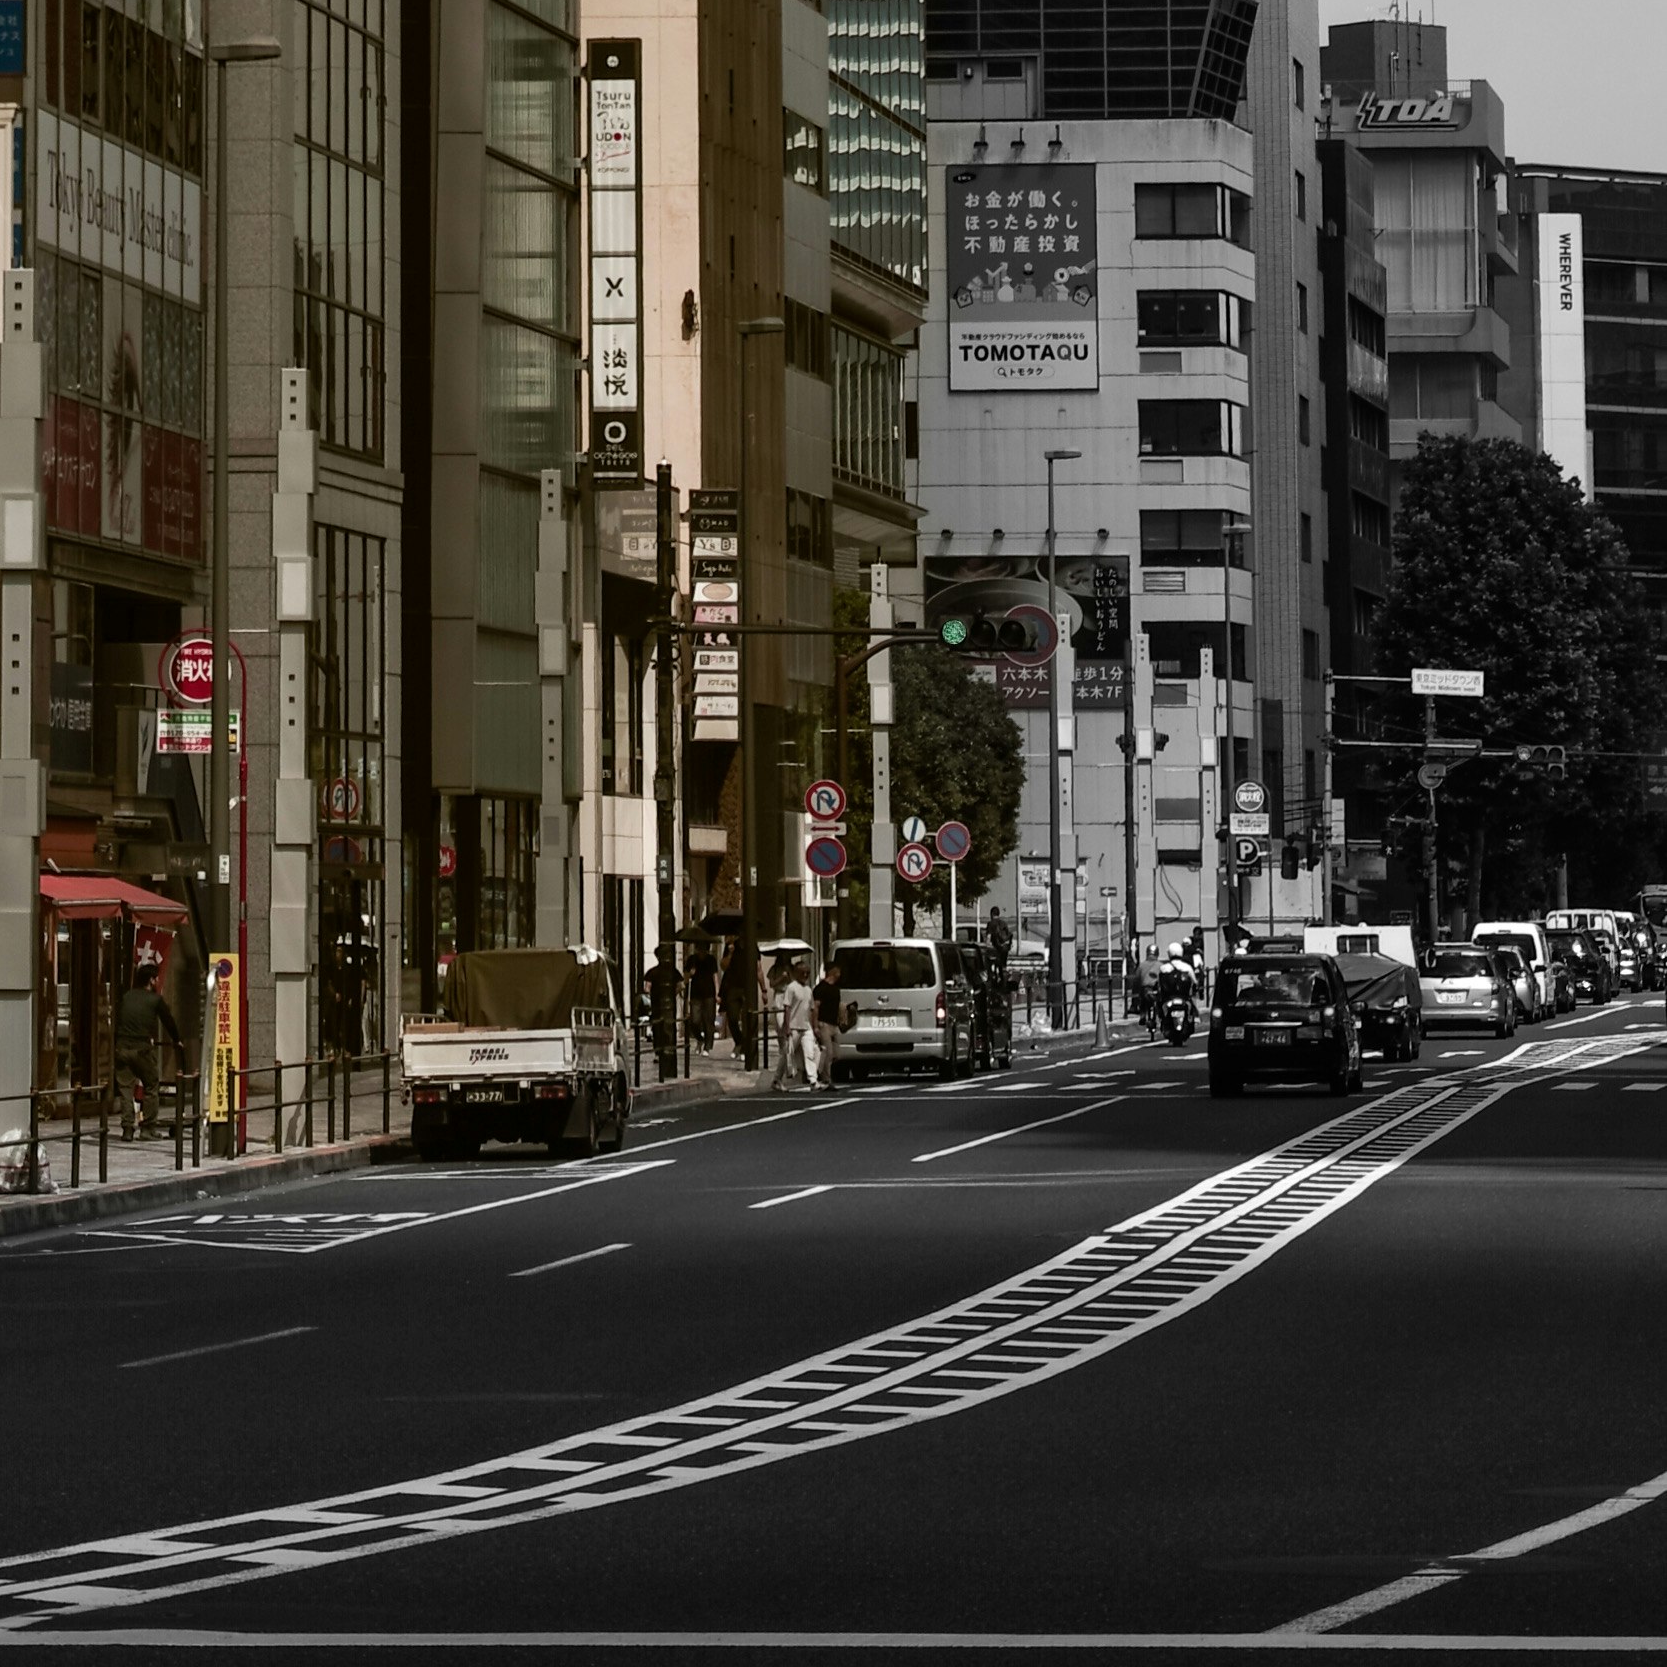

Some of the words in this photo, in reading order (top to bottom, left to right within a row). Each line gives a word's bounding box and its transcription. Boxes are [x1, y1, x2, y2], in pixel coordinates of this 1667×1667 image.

[596, 91, 631, 100] Tsuru
[1377, 98, 1457, 123] TOA
[964, 190, 1079, 209] お金が働く。
[965, 213, 1079, 231] ほったらかし
[964, 235, 1080, 255] 不動産投資
[1557, 232, 1572, 312] WHEREVER
[961, 333, 1086, 342] 不動産クラウドファンディング始めるなら
[959, 343, 1089, 362] TOMOTAQU
[1010, 367, 1044, 377] トモタク
[1108, 568, 1119, 630] たのしい空間
[1095, 569, 1106, 652] おいしいおうどん
[1002, 667, 1049, 681] 六本木
[1239, 841, 1254, 860] P
[218, 981, 231, 1045] 違法駐車禁止
